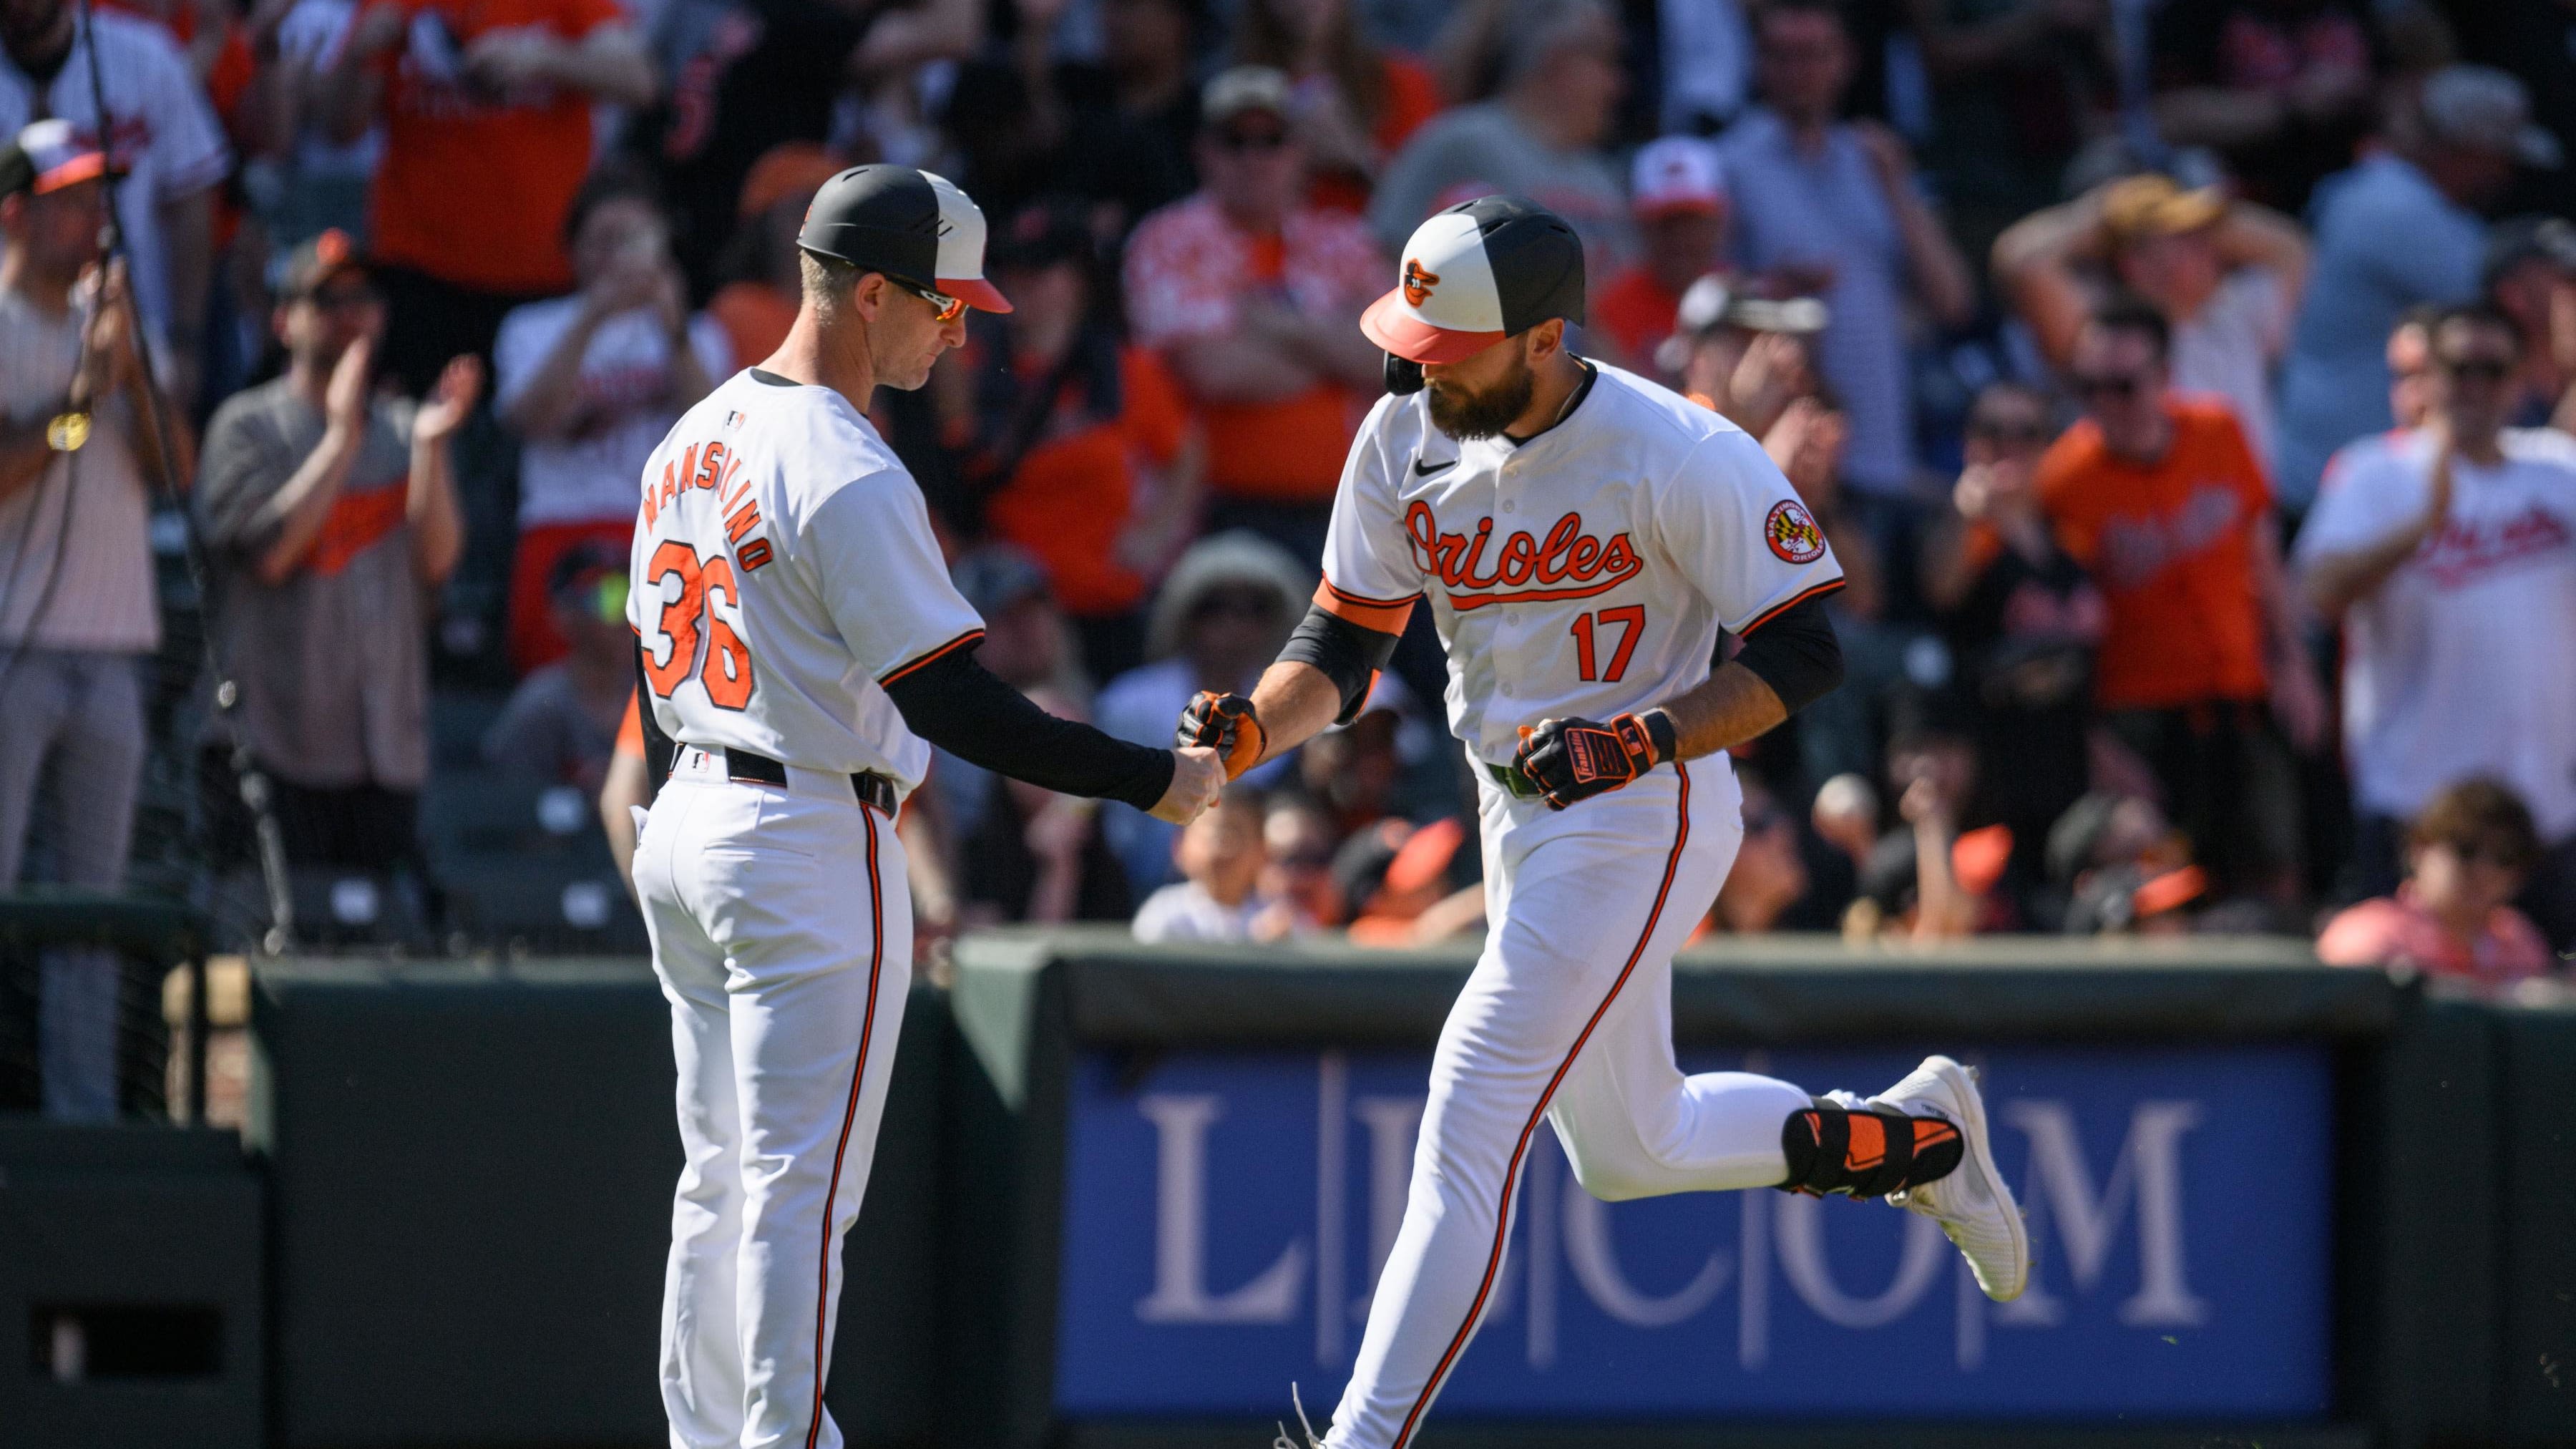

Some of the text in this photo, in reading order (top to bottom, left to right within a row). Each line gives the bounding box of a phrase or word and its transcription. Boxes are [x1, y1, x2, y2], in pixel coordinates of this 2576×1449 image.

[1405, 499, 1644, 592] Orioles
[641, 539, 754, 712] 36
[1571, 604, 1646, 683] 17
